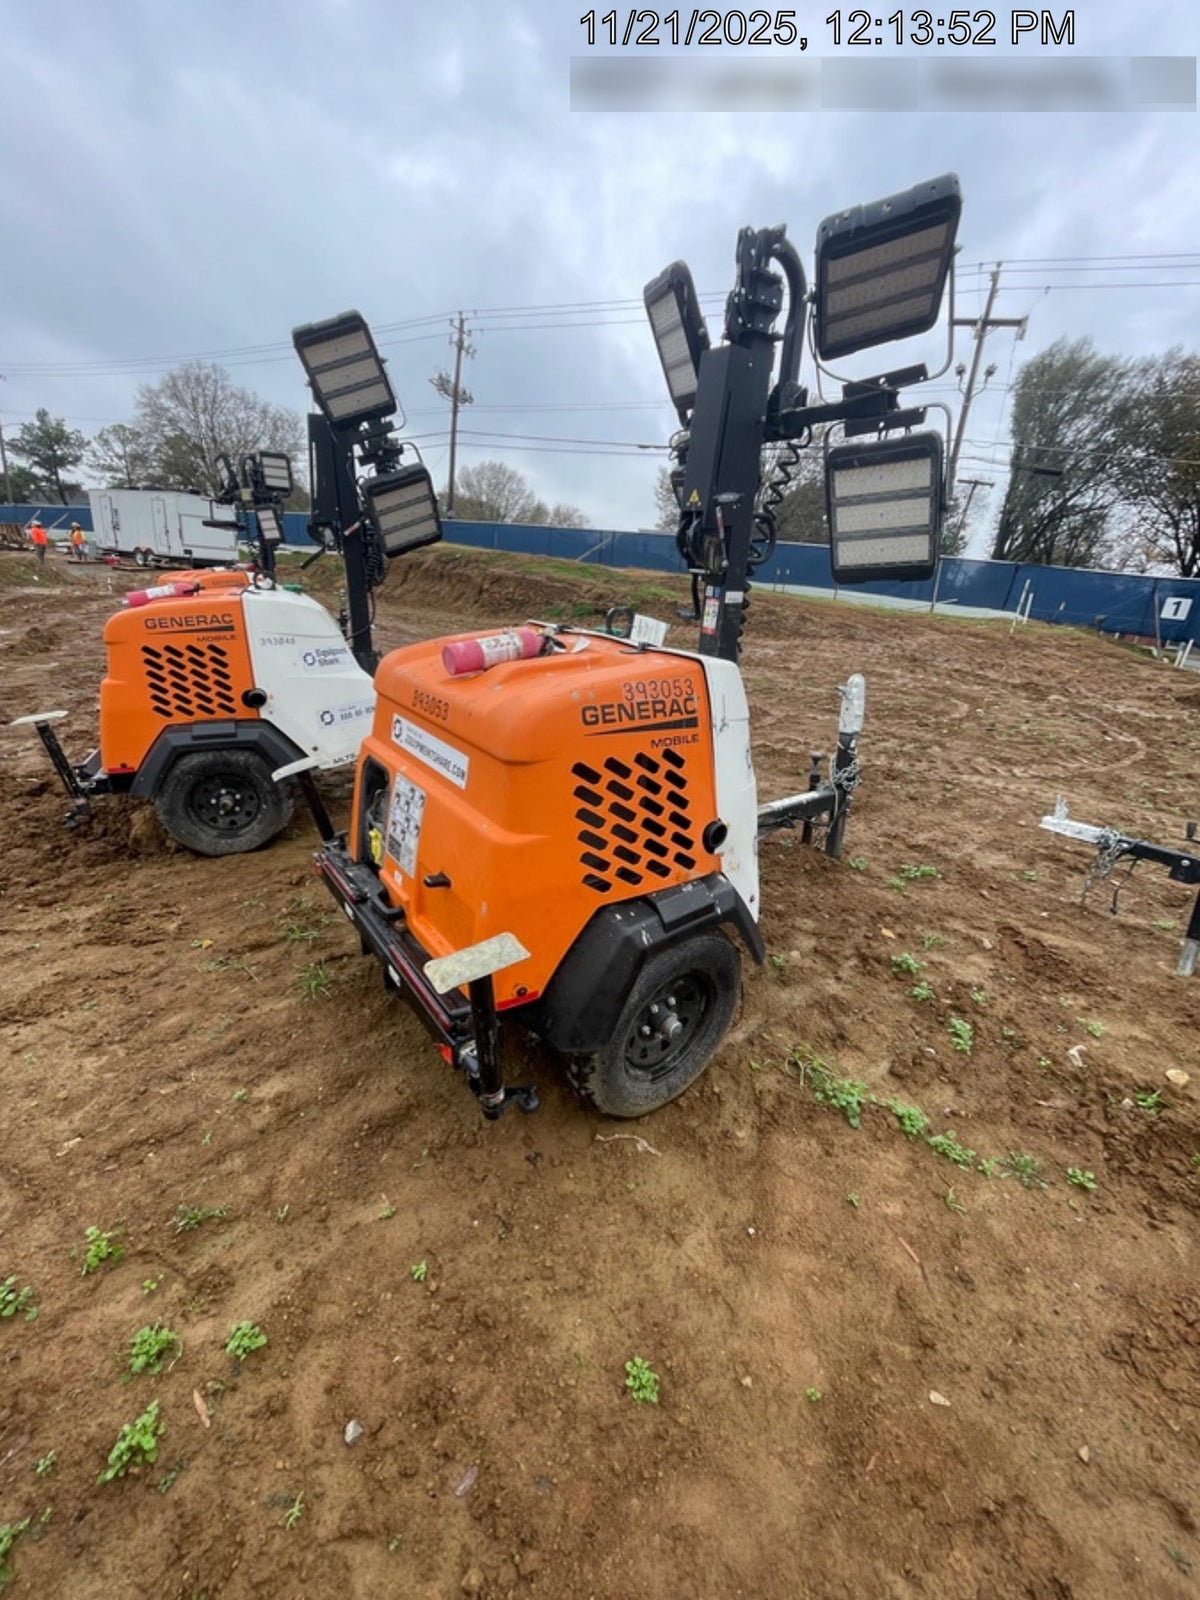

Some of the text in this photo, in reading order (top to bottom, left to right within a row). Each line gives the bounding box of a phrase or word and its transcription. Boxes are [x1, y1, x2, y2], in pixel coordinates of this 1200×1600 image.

[1172, 600, 1182, 617] 1
[144, 613, 234, 630] GENERAC
[196, 634, 237, 643] MOBILE
[623, 678, 695, 702] 393053
[581, 696, 698, 726] GENERAC
[650, 734, 699, 749] MOBILE
